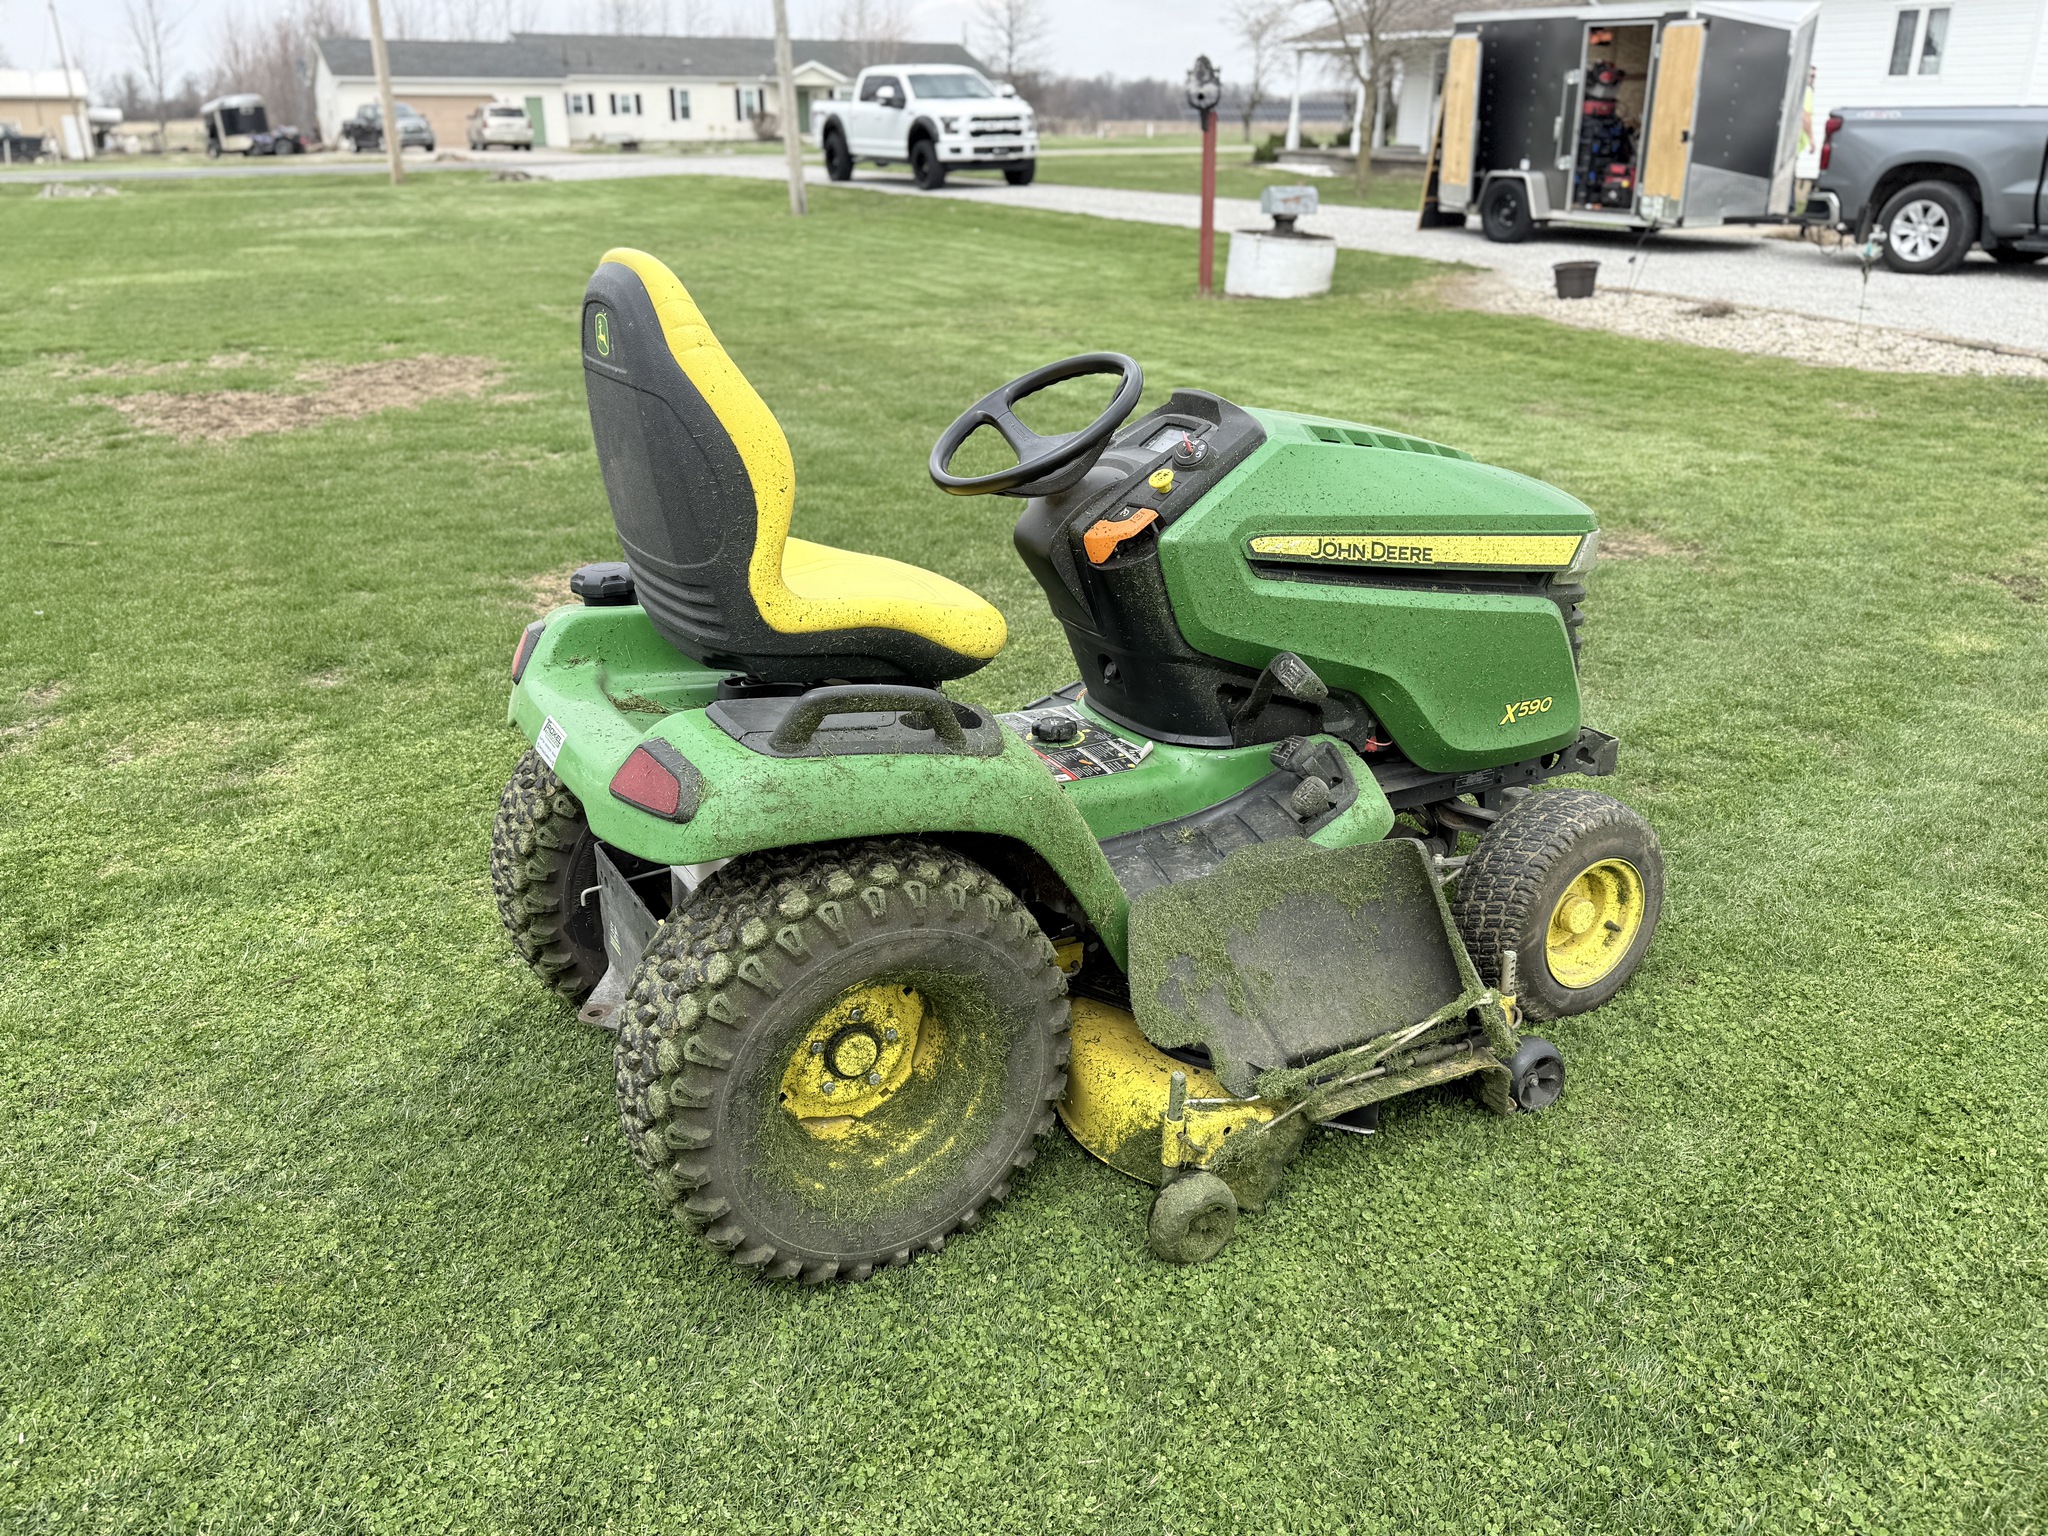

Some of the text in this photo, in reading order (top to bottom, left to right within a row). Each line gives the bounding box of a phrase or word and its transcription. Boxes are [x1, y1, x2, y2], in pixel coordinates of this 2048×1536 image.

[1311, 538, 1433, 562] JOHN DEERE
[1498, 696, 1553, 726] X590
